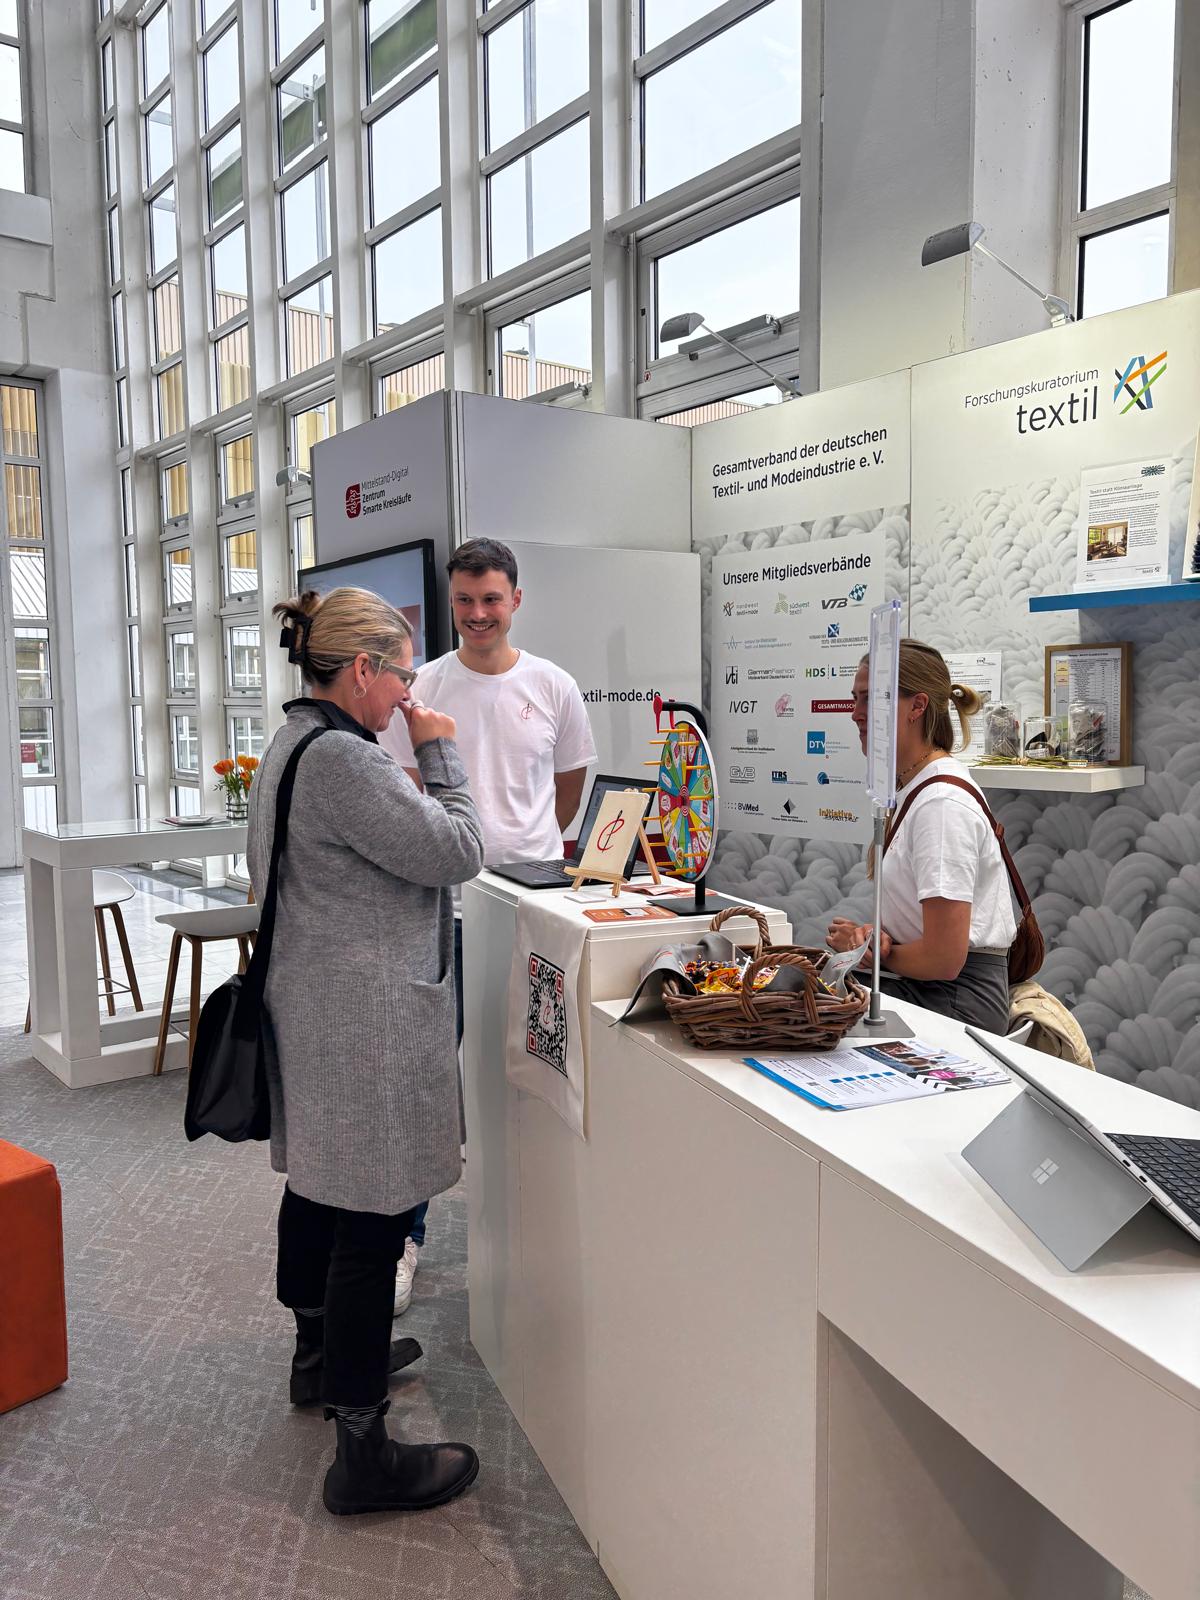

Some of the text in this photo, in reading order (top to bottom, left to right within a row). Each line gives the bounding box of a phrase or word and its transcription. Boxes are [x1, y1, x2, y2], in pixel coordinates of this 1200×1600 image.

[964, 369, 1099, 408] Forschungskuratorium
[1016, 385, 1098, 434] textil
[712, 428, 887, 477] Gesamtverband der deutschen
[361, 465, 409, 491] Mittelstand-Digital
[712, 450, 884, 499] Textil- und Modeindustrie e. V.
[362, 489, 386, 504] Zentrum
[363, 493, 412, 516] Smarte Kreisläufe
[723, 553, 871, 585] Unsere Mitgliedsverbände
[821, 598, 848, 610] VTB
[805, 667, 826, 678] HDS
[581, 689, 661, 702] xtil-mode.d
[729, 700, 758, 714] IVGT
[817, 702, 857, 710] GESAMTMASCH
